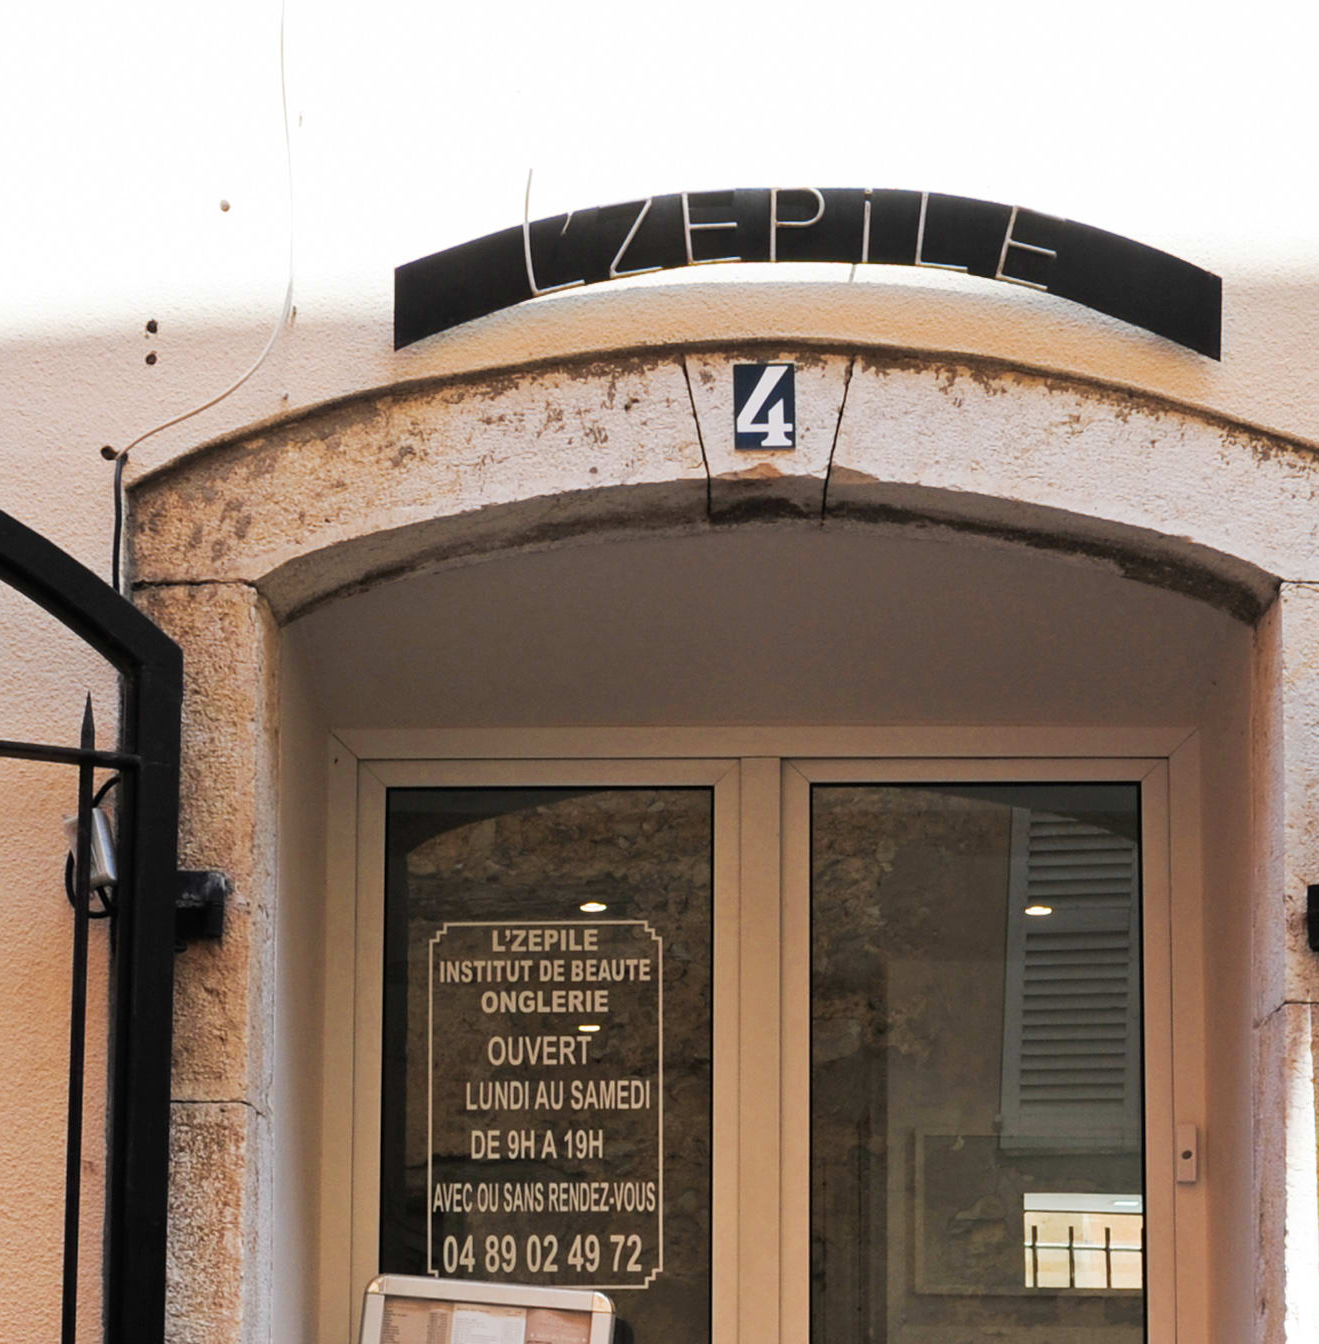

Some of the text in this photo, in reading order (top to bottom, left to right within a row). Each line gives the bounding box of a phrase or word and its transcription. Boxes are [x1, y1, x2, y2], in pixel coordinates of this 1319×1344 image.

[736, 365, 793, 448] 4
[491, 929, 599, 952] L'ZEPILE
[439, 958, 651, 983] INSTITUT DE BEAUTE
[481, 990, 609, 1013] ONGLERIE
[487, 1035, 592, 1066] OUVERT
[466, 1080, 651, 1111] LUNDI AU SAMEDI
[470, 1129, 604, 1160] DE 9H A 19H
[433, 1182, 656, 1213] AVEC OU SANS RENDEZ-VOUS
[443, 1234, 643, 1273] 04 89 02 49 72
